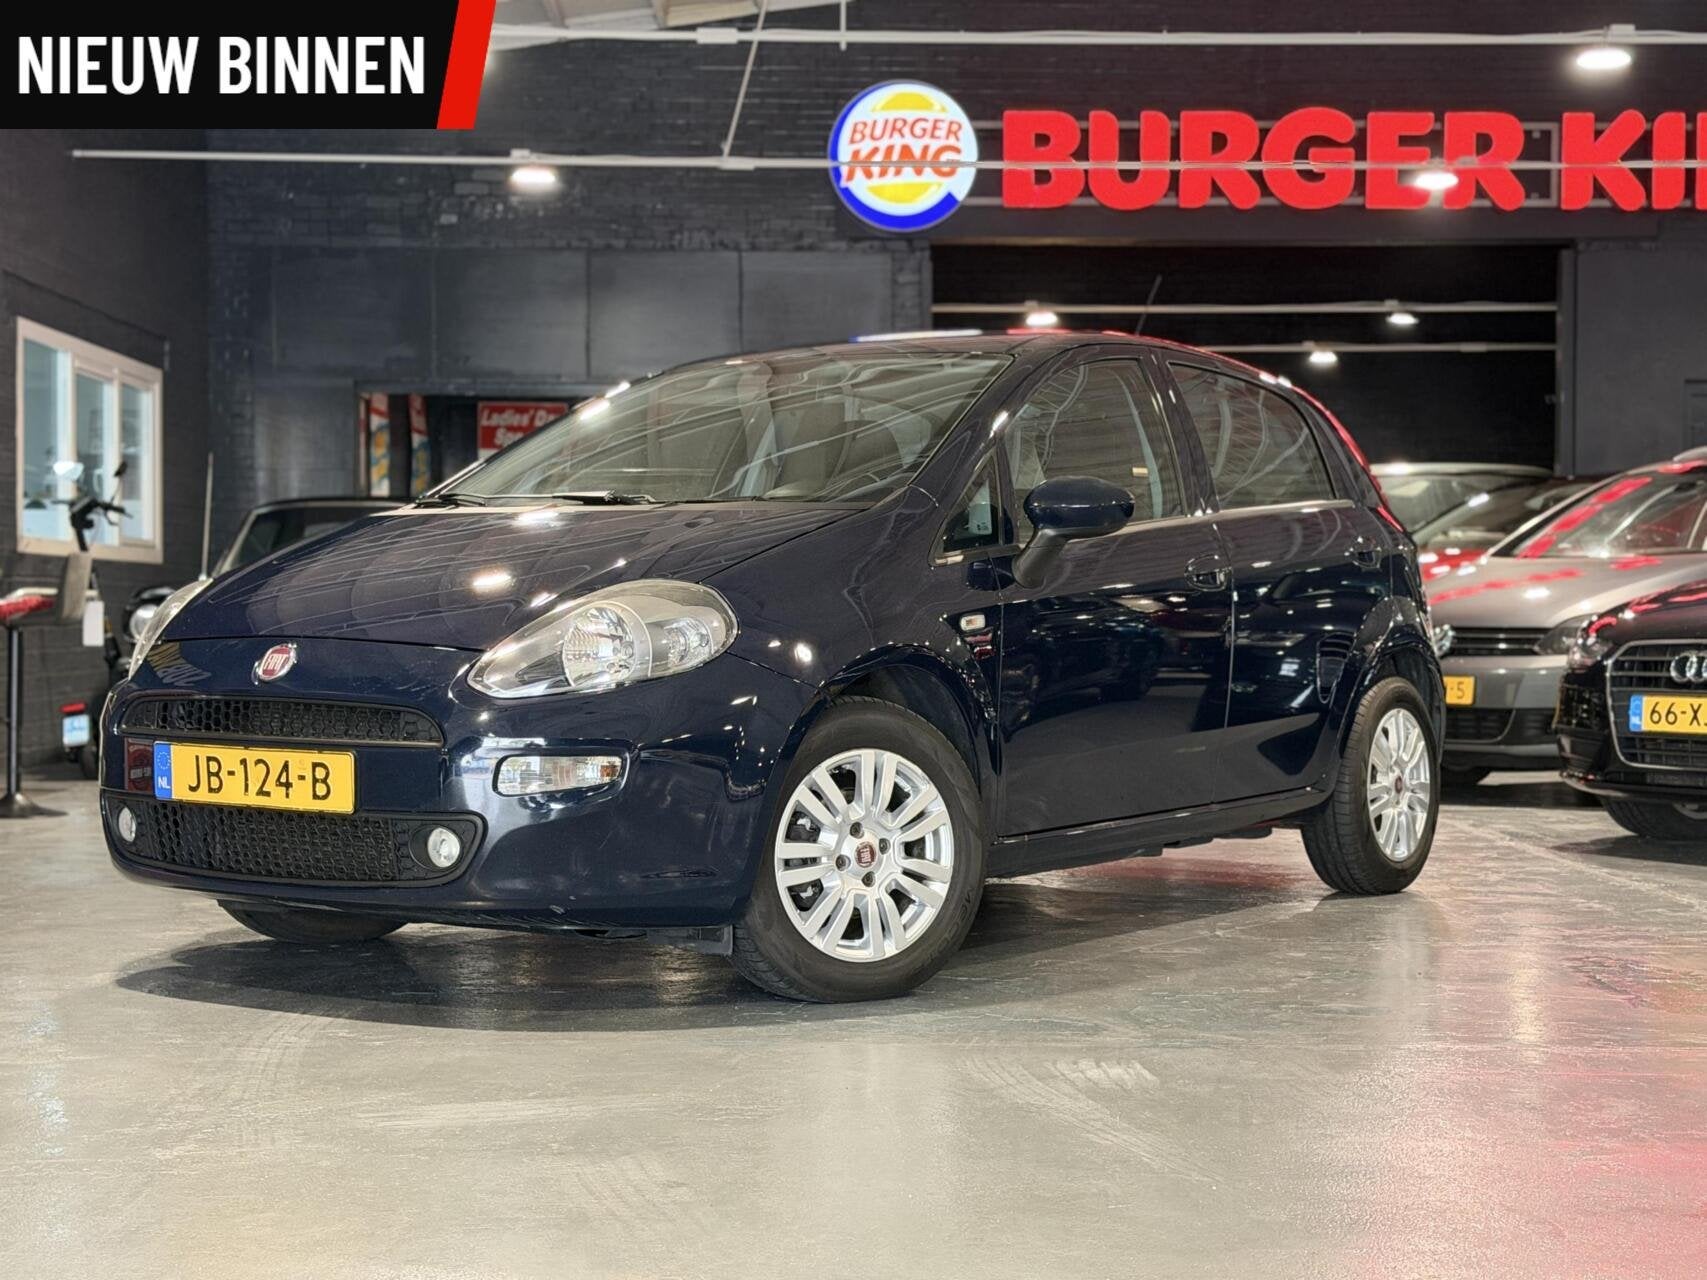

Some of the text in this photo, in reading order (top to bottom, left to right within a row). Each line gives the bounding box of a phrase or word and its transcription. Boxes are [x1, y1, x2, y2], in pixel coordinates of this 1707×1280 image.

[849, 117, 963, 145] BURGER
[846, 143, 962, 184] KING
[1002, 107, 1707, 212] BURGER KI
[262, 653, 290, 675] FIAT
[1649, 701, 1707, 726] 66-X
[157, 776, 171, 789] NL
[188, 755, 332, 801] JB-124-B
